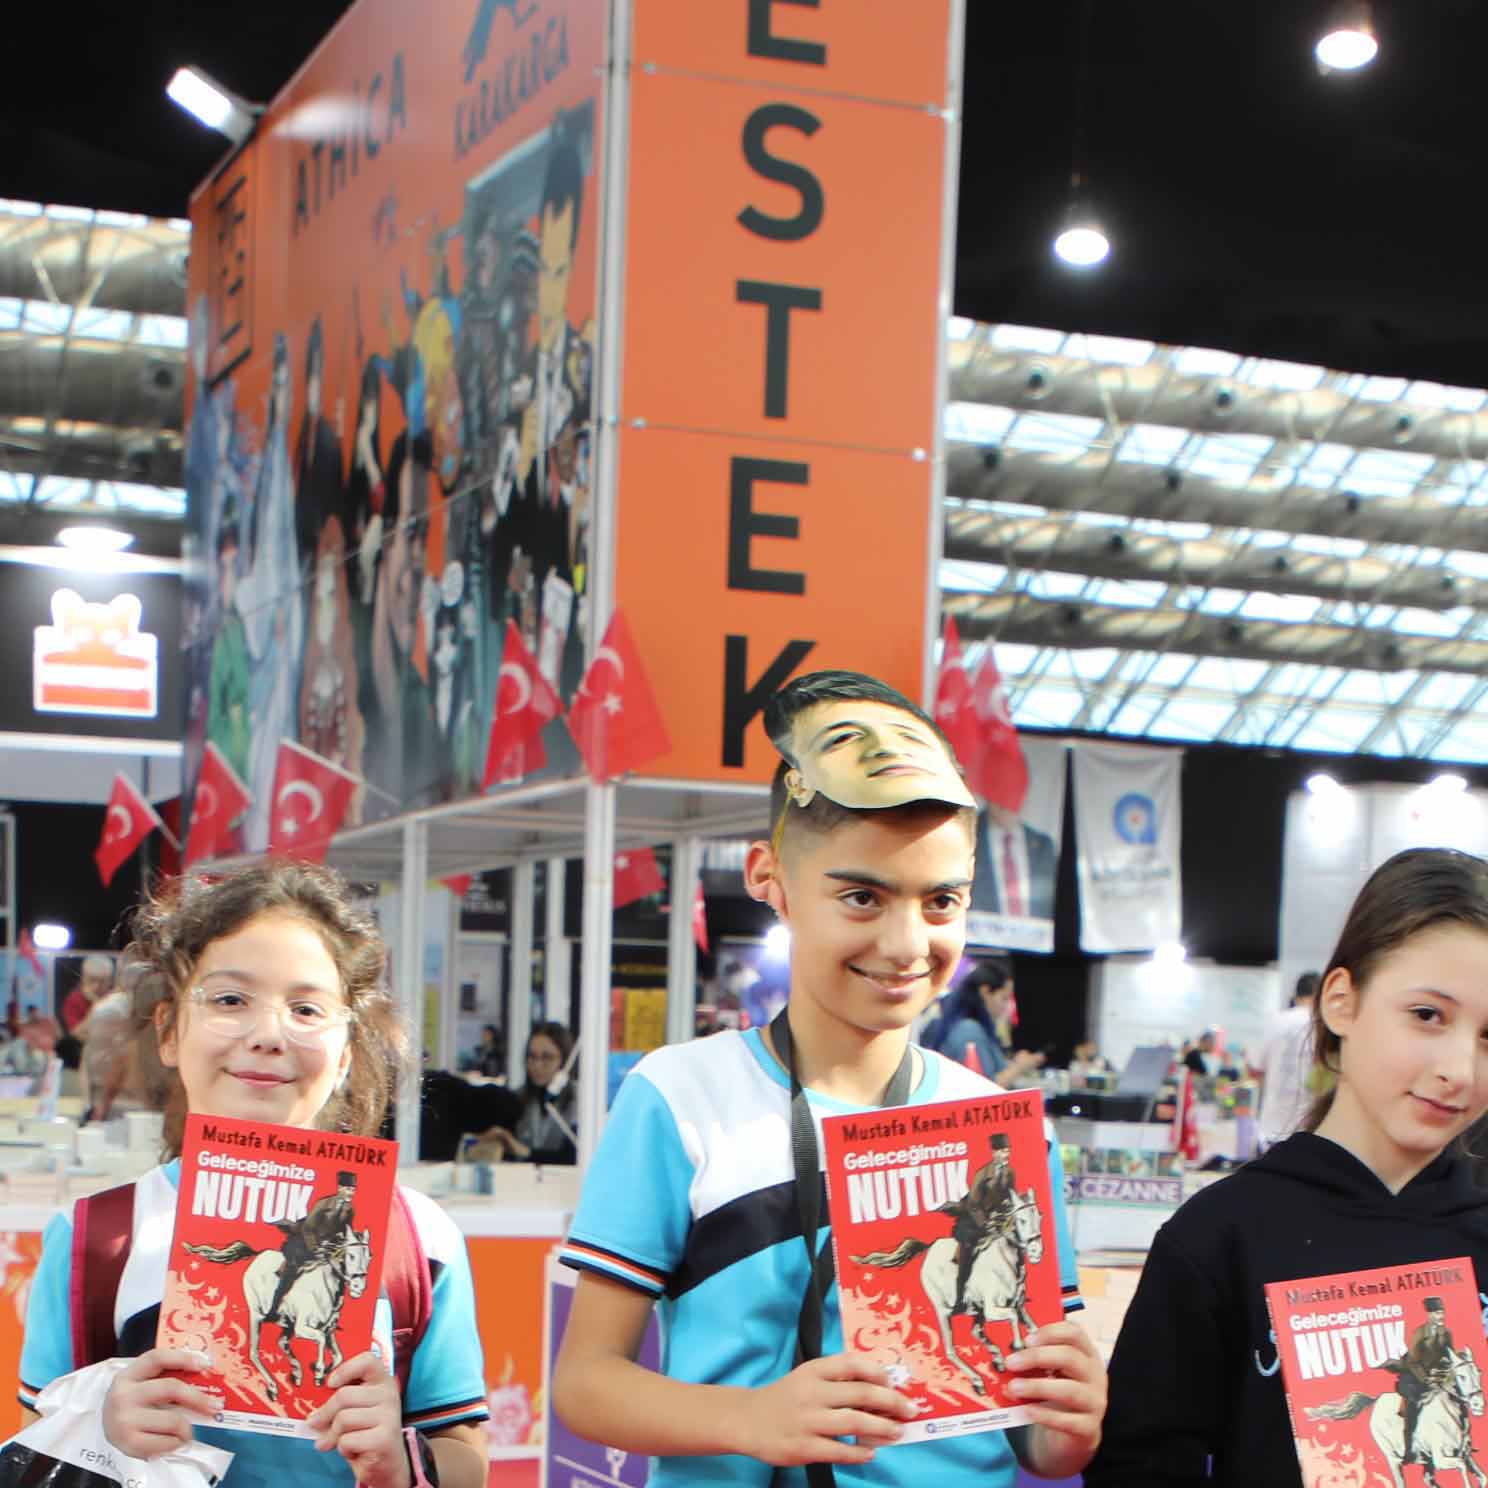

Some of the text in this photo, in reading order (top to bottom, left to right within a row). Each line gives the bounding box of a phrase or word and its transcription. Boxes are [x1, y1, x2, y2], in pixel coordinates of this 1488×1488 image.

[842, 1100, 1033, 1143] Mustafa Kemal ATATÜRK
[202, 1124, 387, 1166] Mustafa Kemal ATATÜRK
[843, 1139, 967, 1170] Geleceğimize
[197, 1151, 315, 1182] Geleceğimize
[191, 1170, 315, 1224] NUTUK
[848, 1160, 969, 1224] NUTUK
[1286, 1267, 1464, 1306] Mustafa Kemal ATATÜRK
[1289, 1303, 1402, 1331] Geleceğimize
[1295, 1320, 1409, 1380] NUTUK
